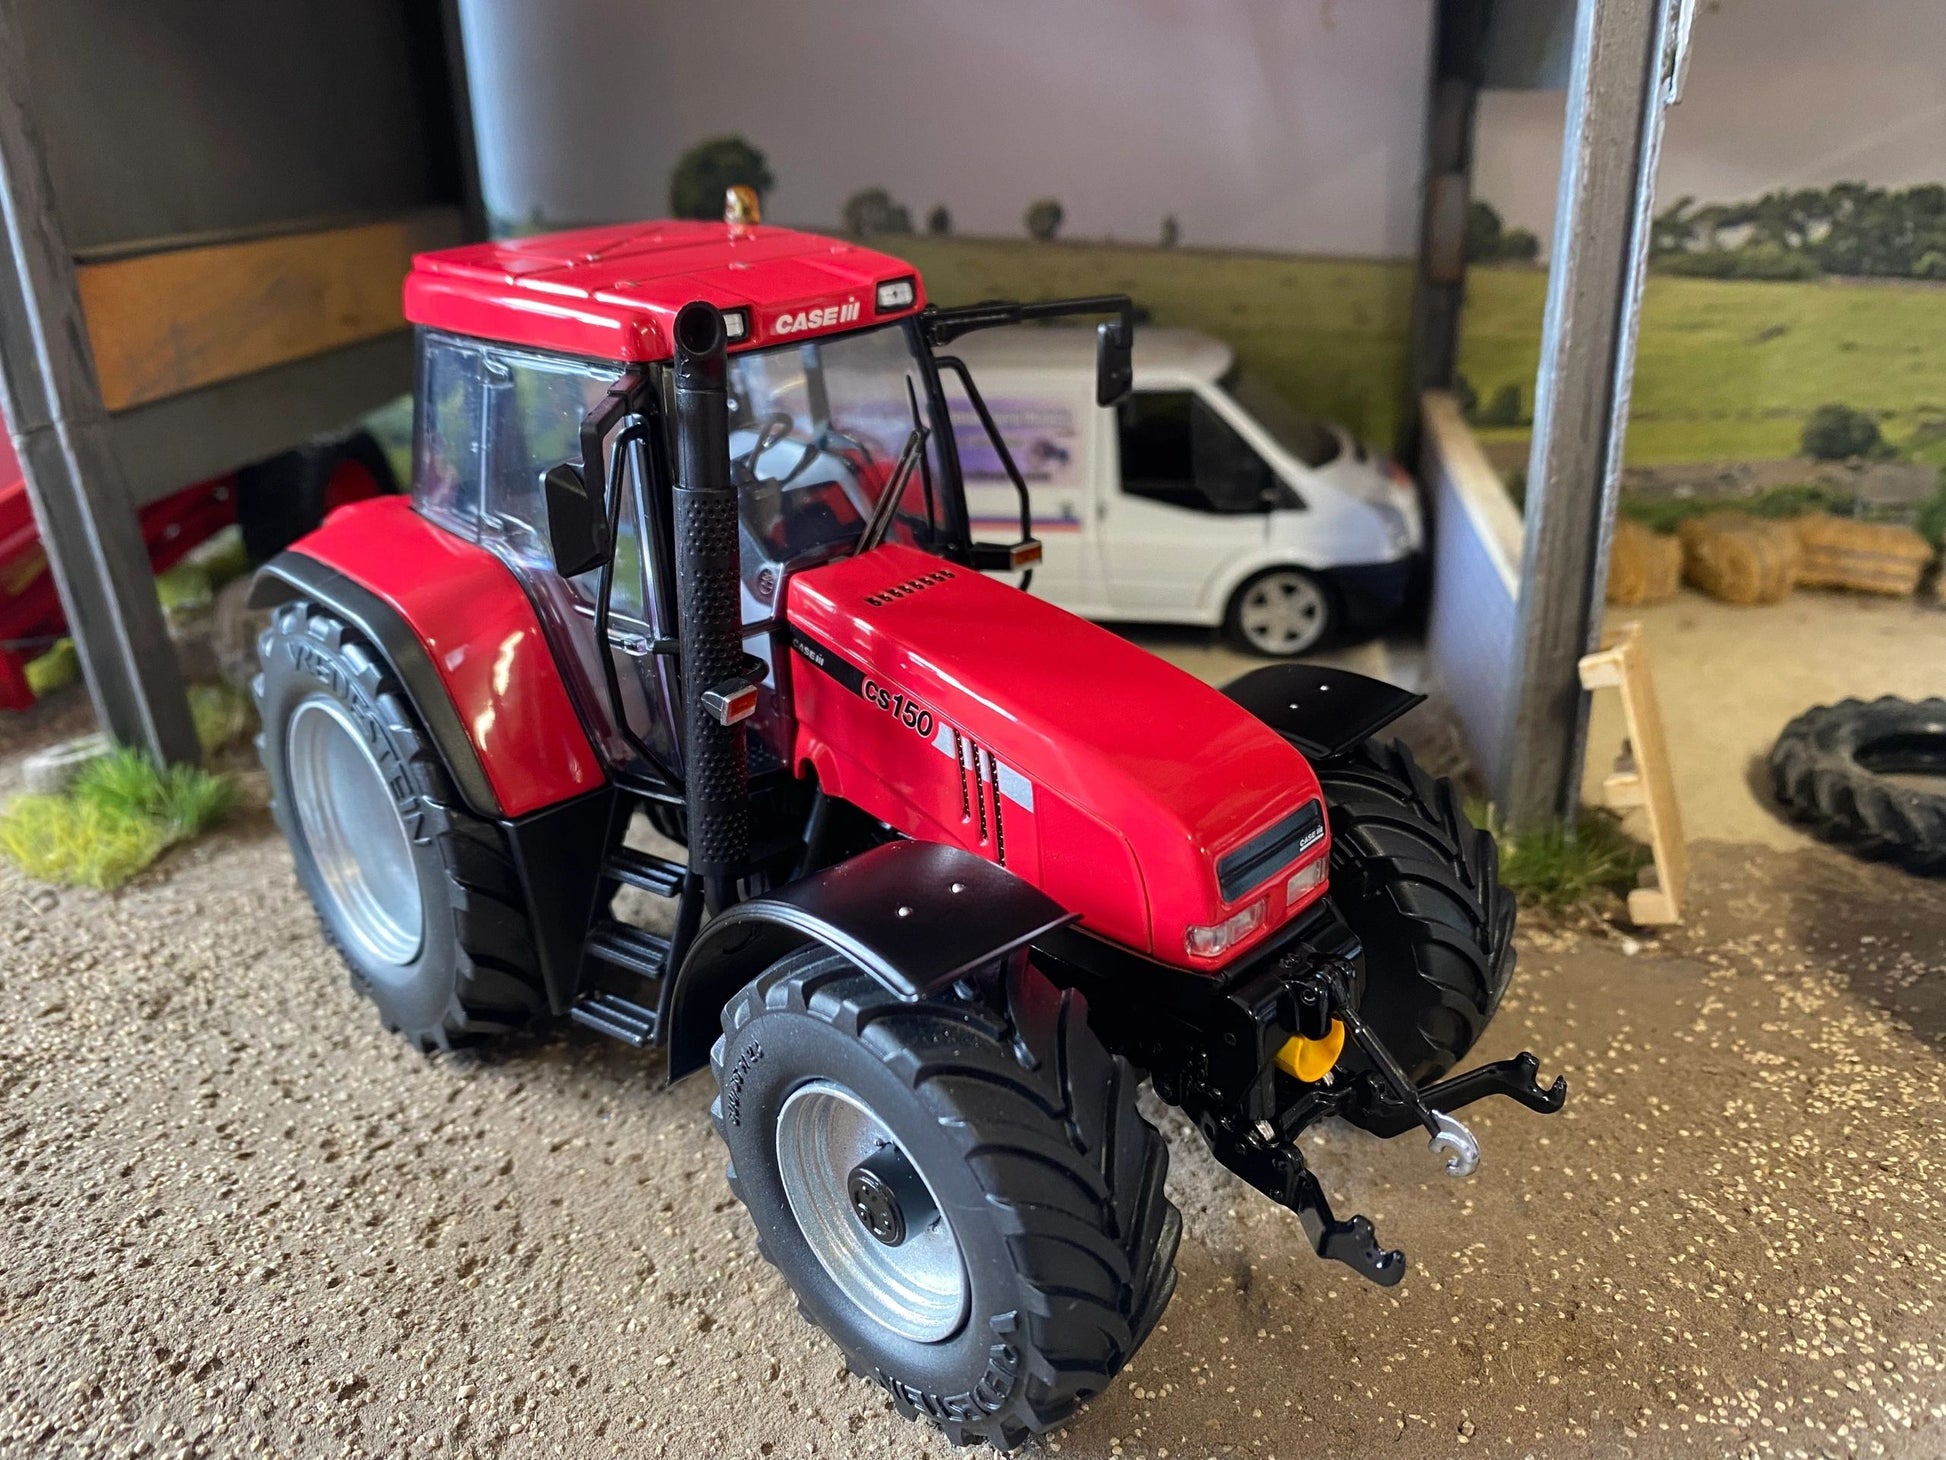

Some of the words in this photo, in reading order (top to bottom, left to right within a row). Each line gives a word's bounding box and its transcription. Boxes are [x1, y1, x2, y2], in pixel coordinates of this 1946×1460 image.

[775, 306, 839, 335] CASE
[792, 638, 815, 661] CASE
[862, 677, 934, 738] CS150
